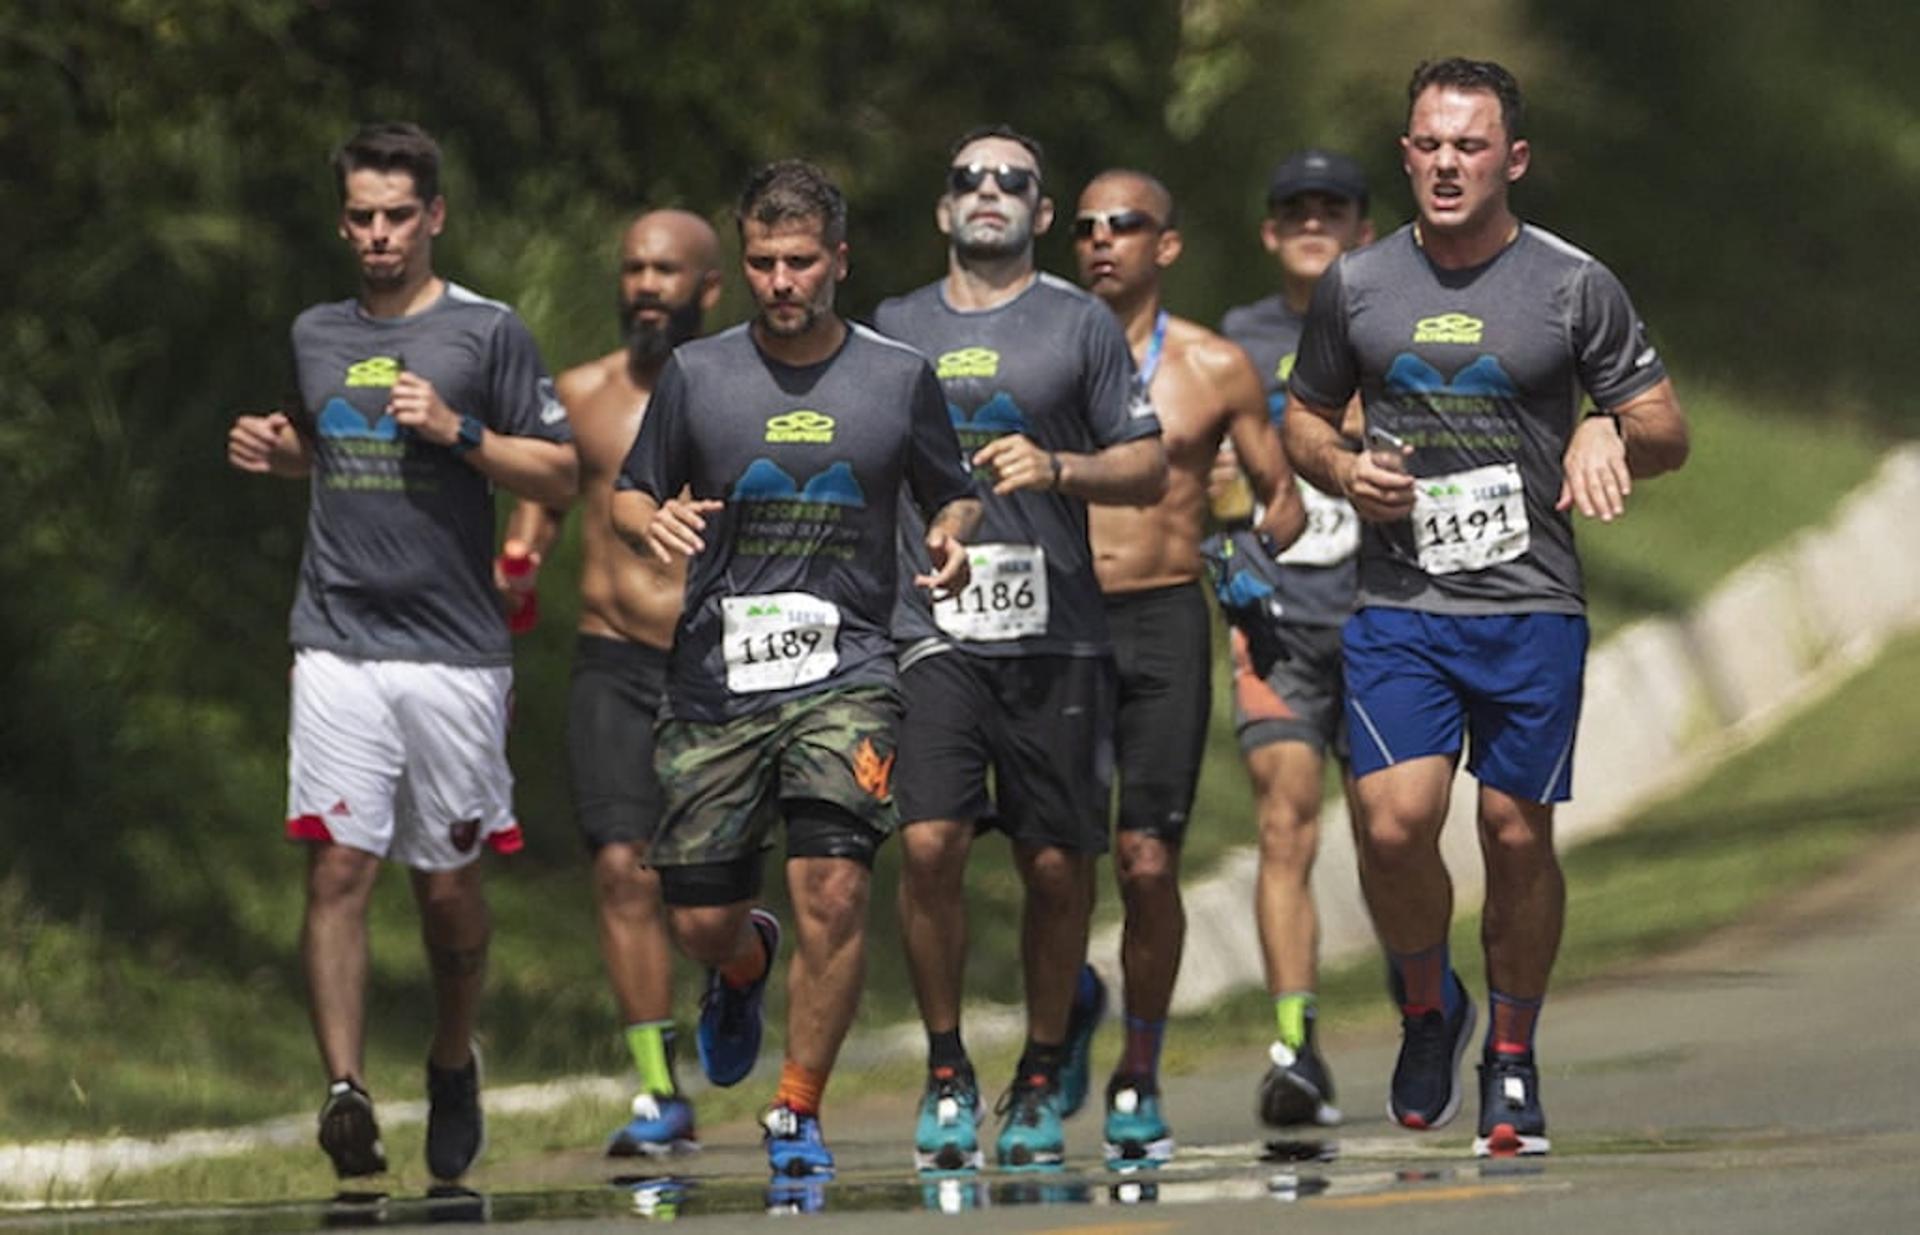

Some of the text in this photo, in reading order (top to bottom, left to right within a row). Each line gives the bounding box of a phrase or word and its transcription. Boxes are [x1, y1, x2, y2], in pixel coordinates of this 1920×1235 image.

[1425, 503, 1515, 546] 1191
[952, 580, 1035, 614] 1186
[739, 630, 822, 664] 1189
